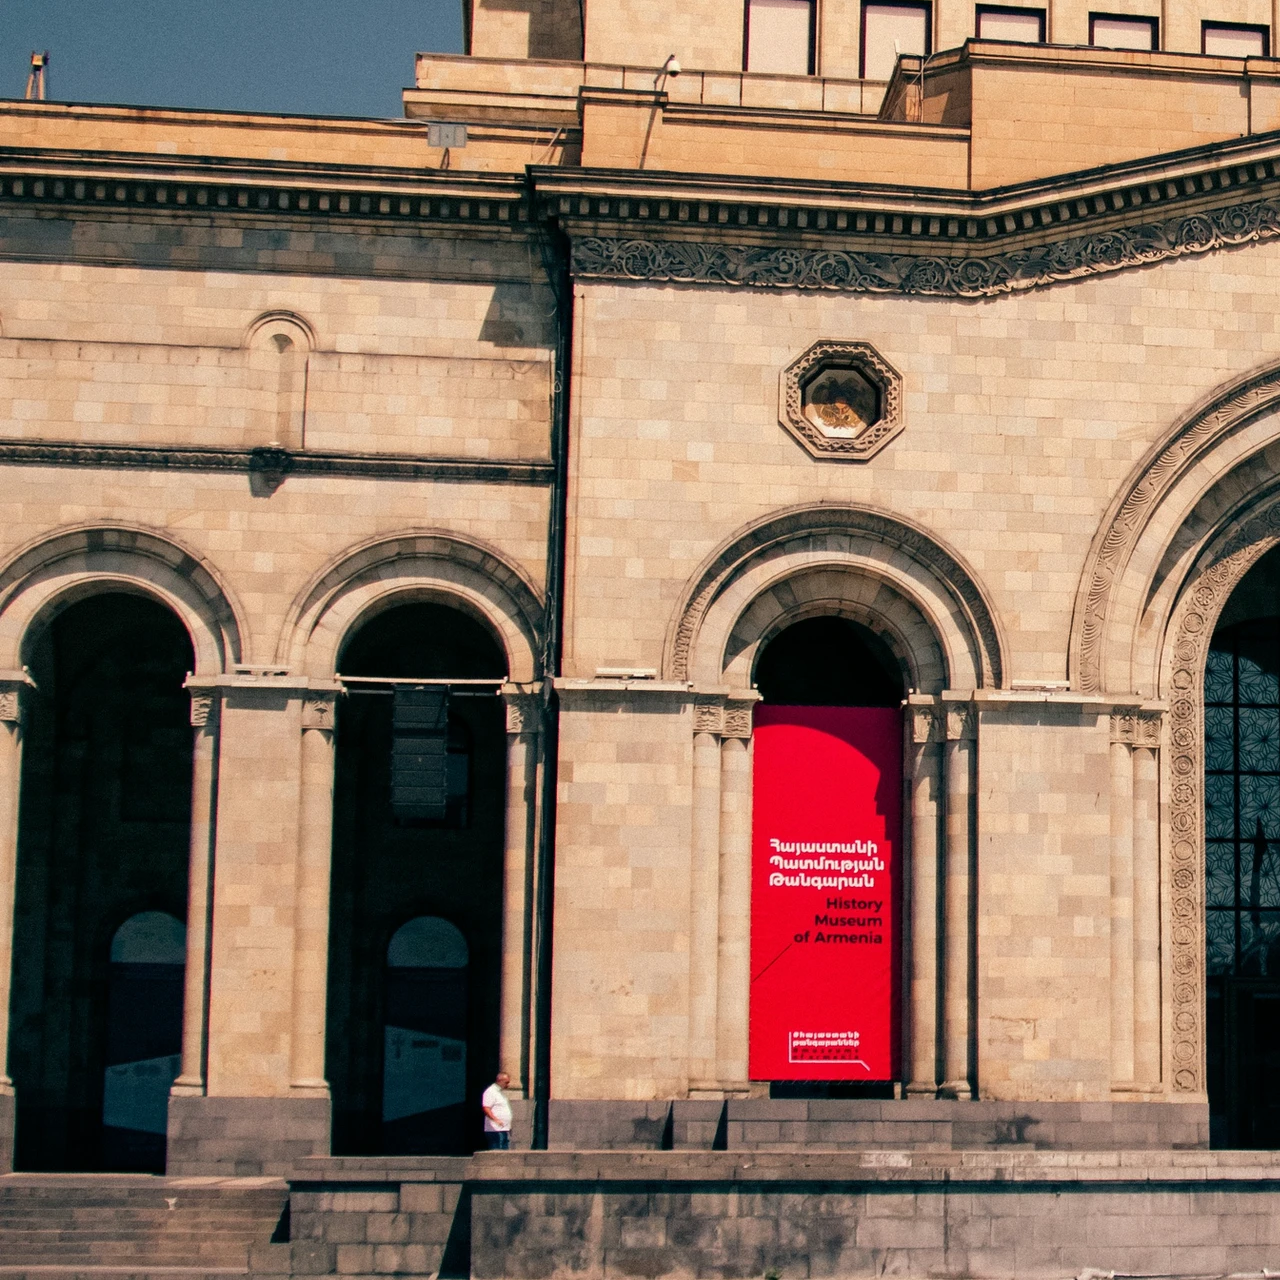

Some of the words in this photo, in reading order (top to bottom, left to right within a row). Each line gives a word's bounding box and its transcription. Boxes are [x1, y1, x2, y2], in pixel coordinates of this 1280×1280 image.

[769, 838, 878, 857] Հայաստանի
[769, 855, 885, 874] Պատմության
[769, 872, 875, 891] Թանգարան
[826, 896, 883, 913] History
[814, 914, 883, 927] Museum
[793, 930, 810, 943] of
[814, 931, 883, 944] Armenia
